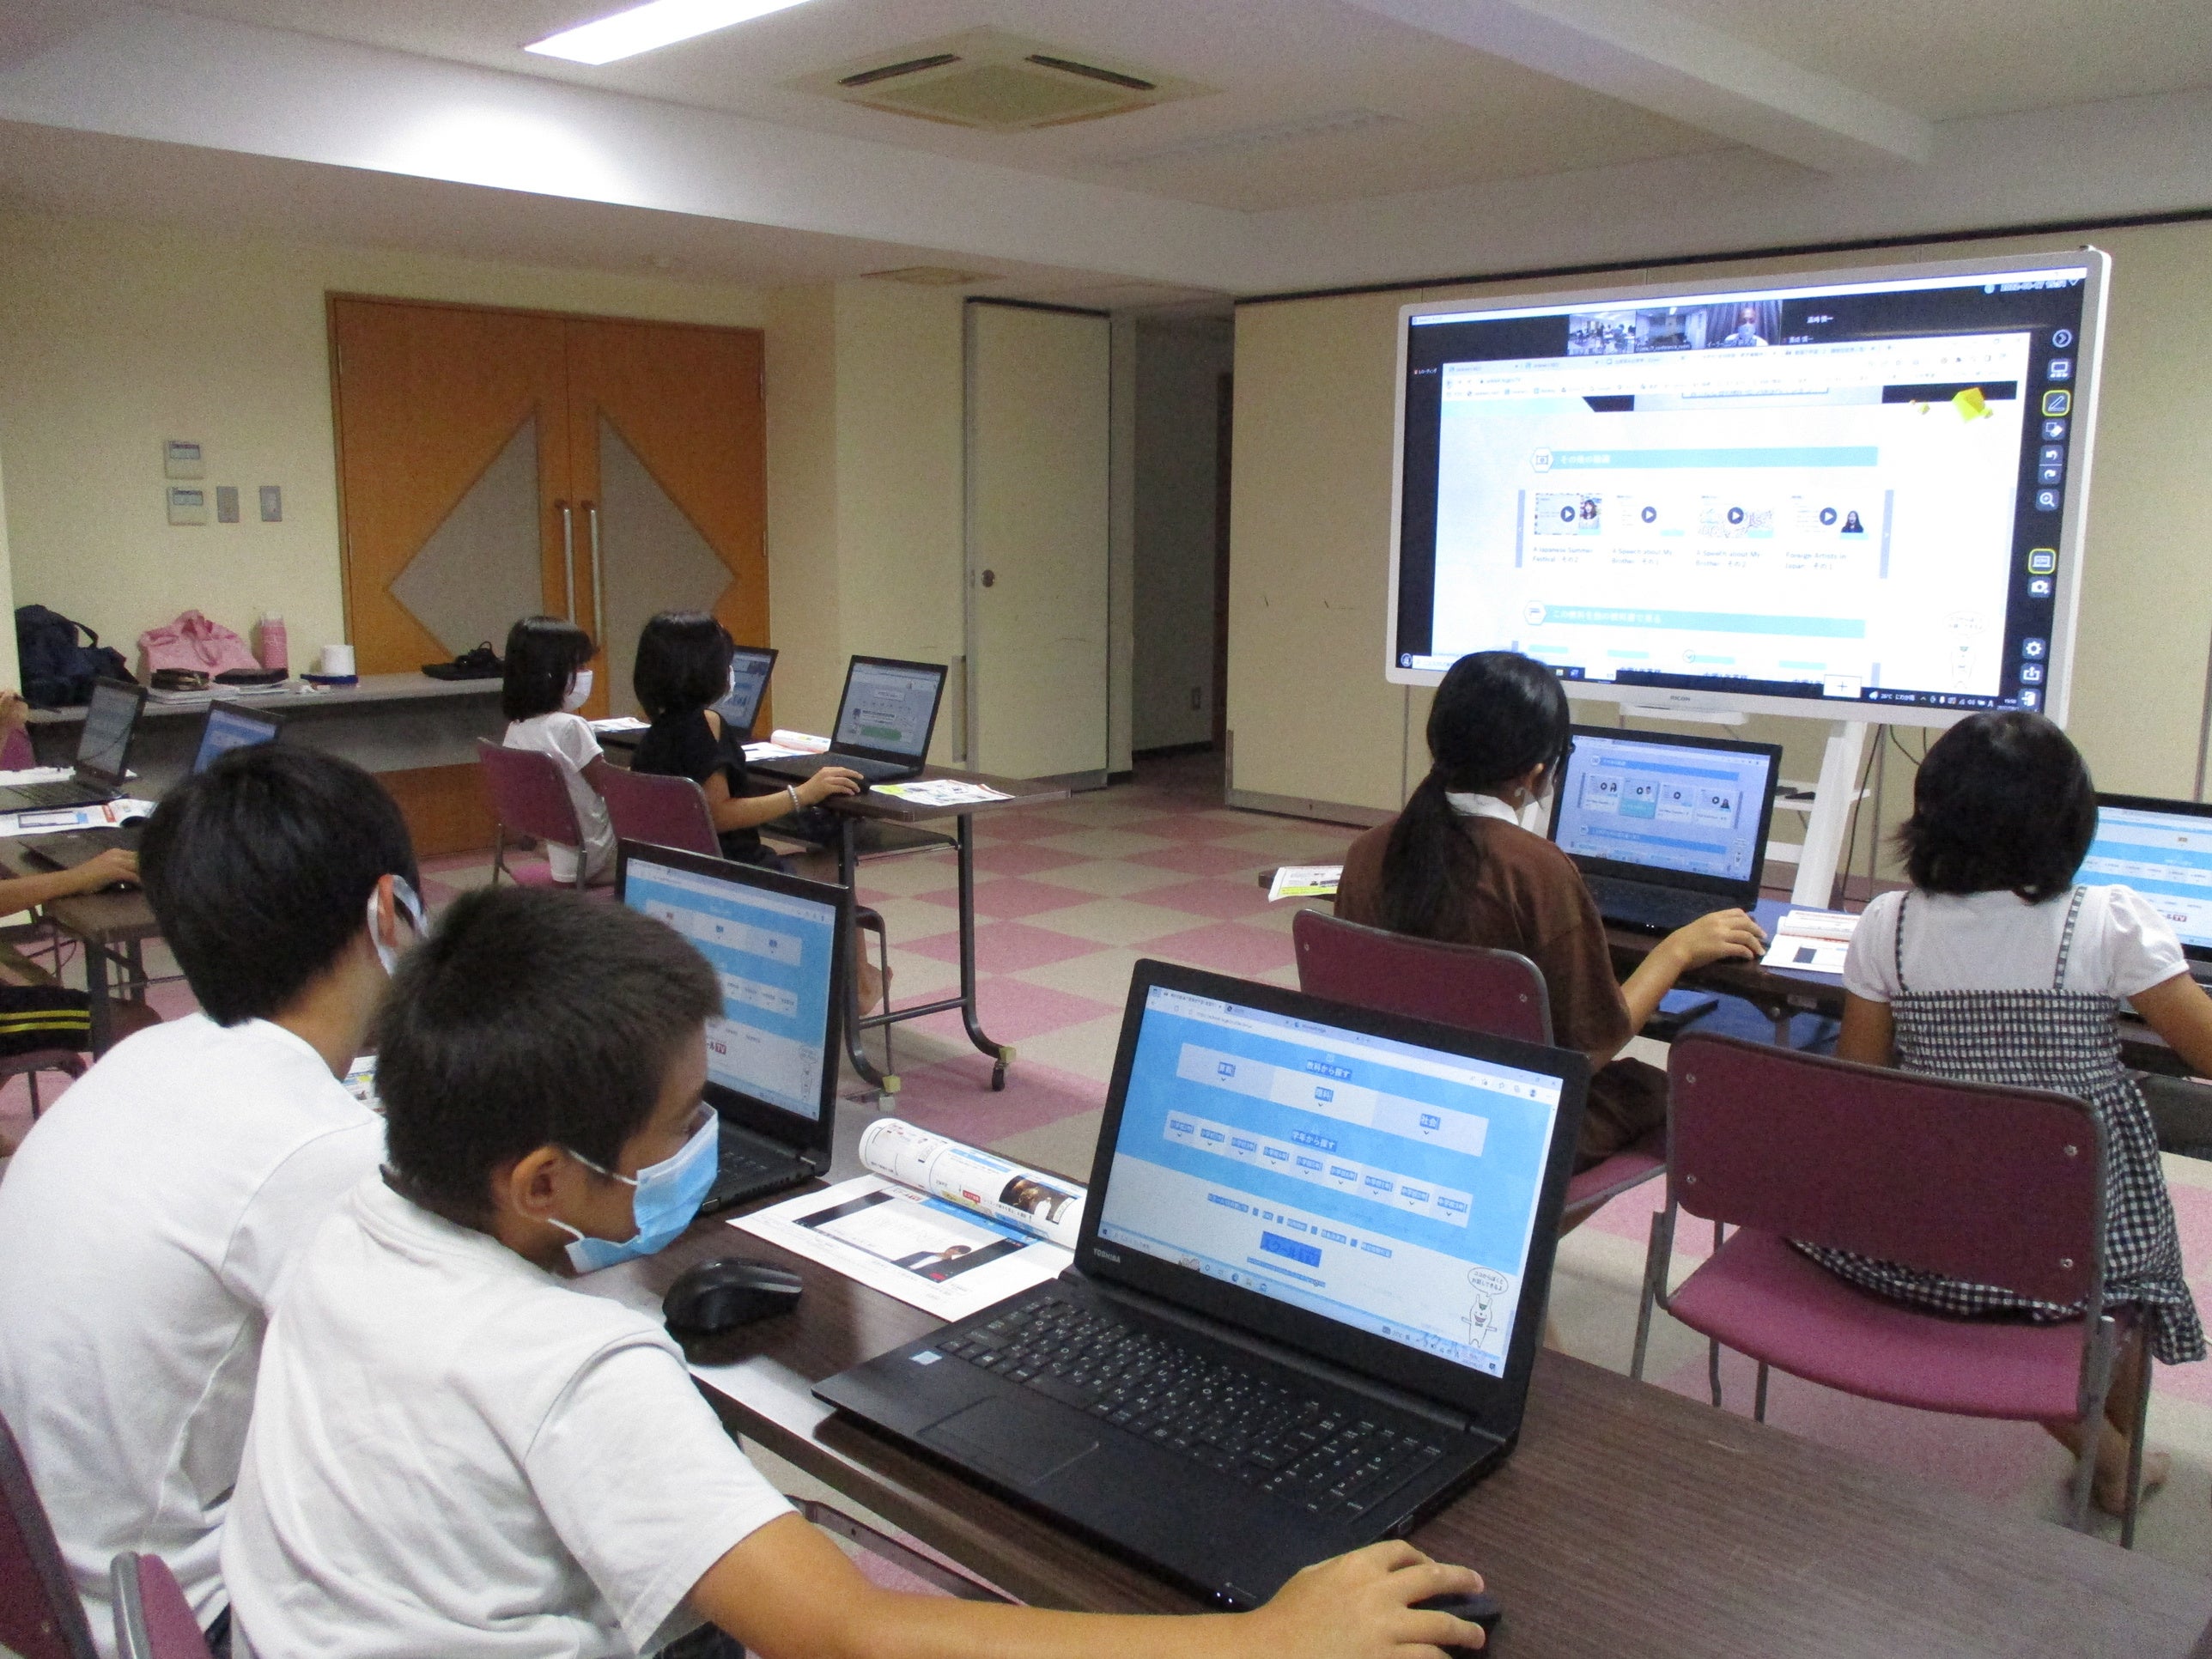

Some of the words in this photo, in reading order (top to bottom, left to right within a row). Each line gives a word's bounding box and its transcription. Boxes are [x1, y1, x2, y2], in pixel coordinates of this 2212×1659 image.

[1306, 1060, 1352, 1079] 教科から探す
[1093, 1248, 1121, 1263] TOSHIBA
